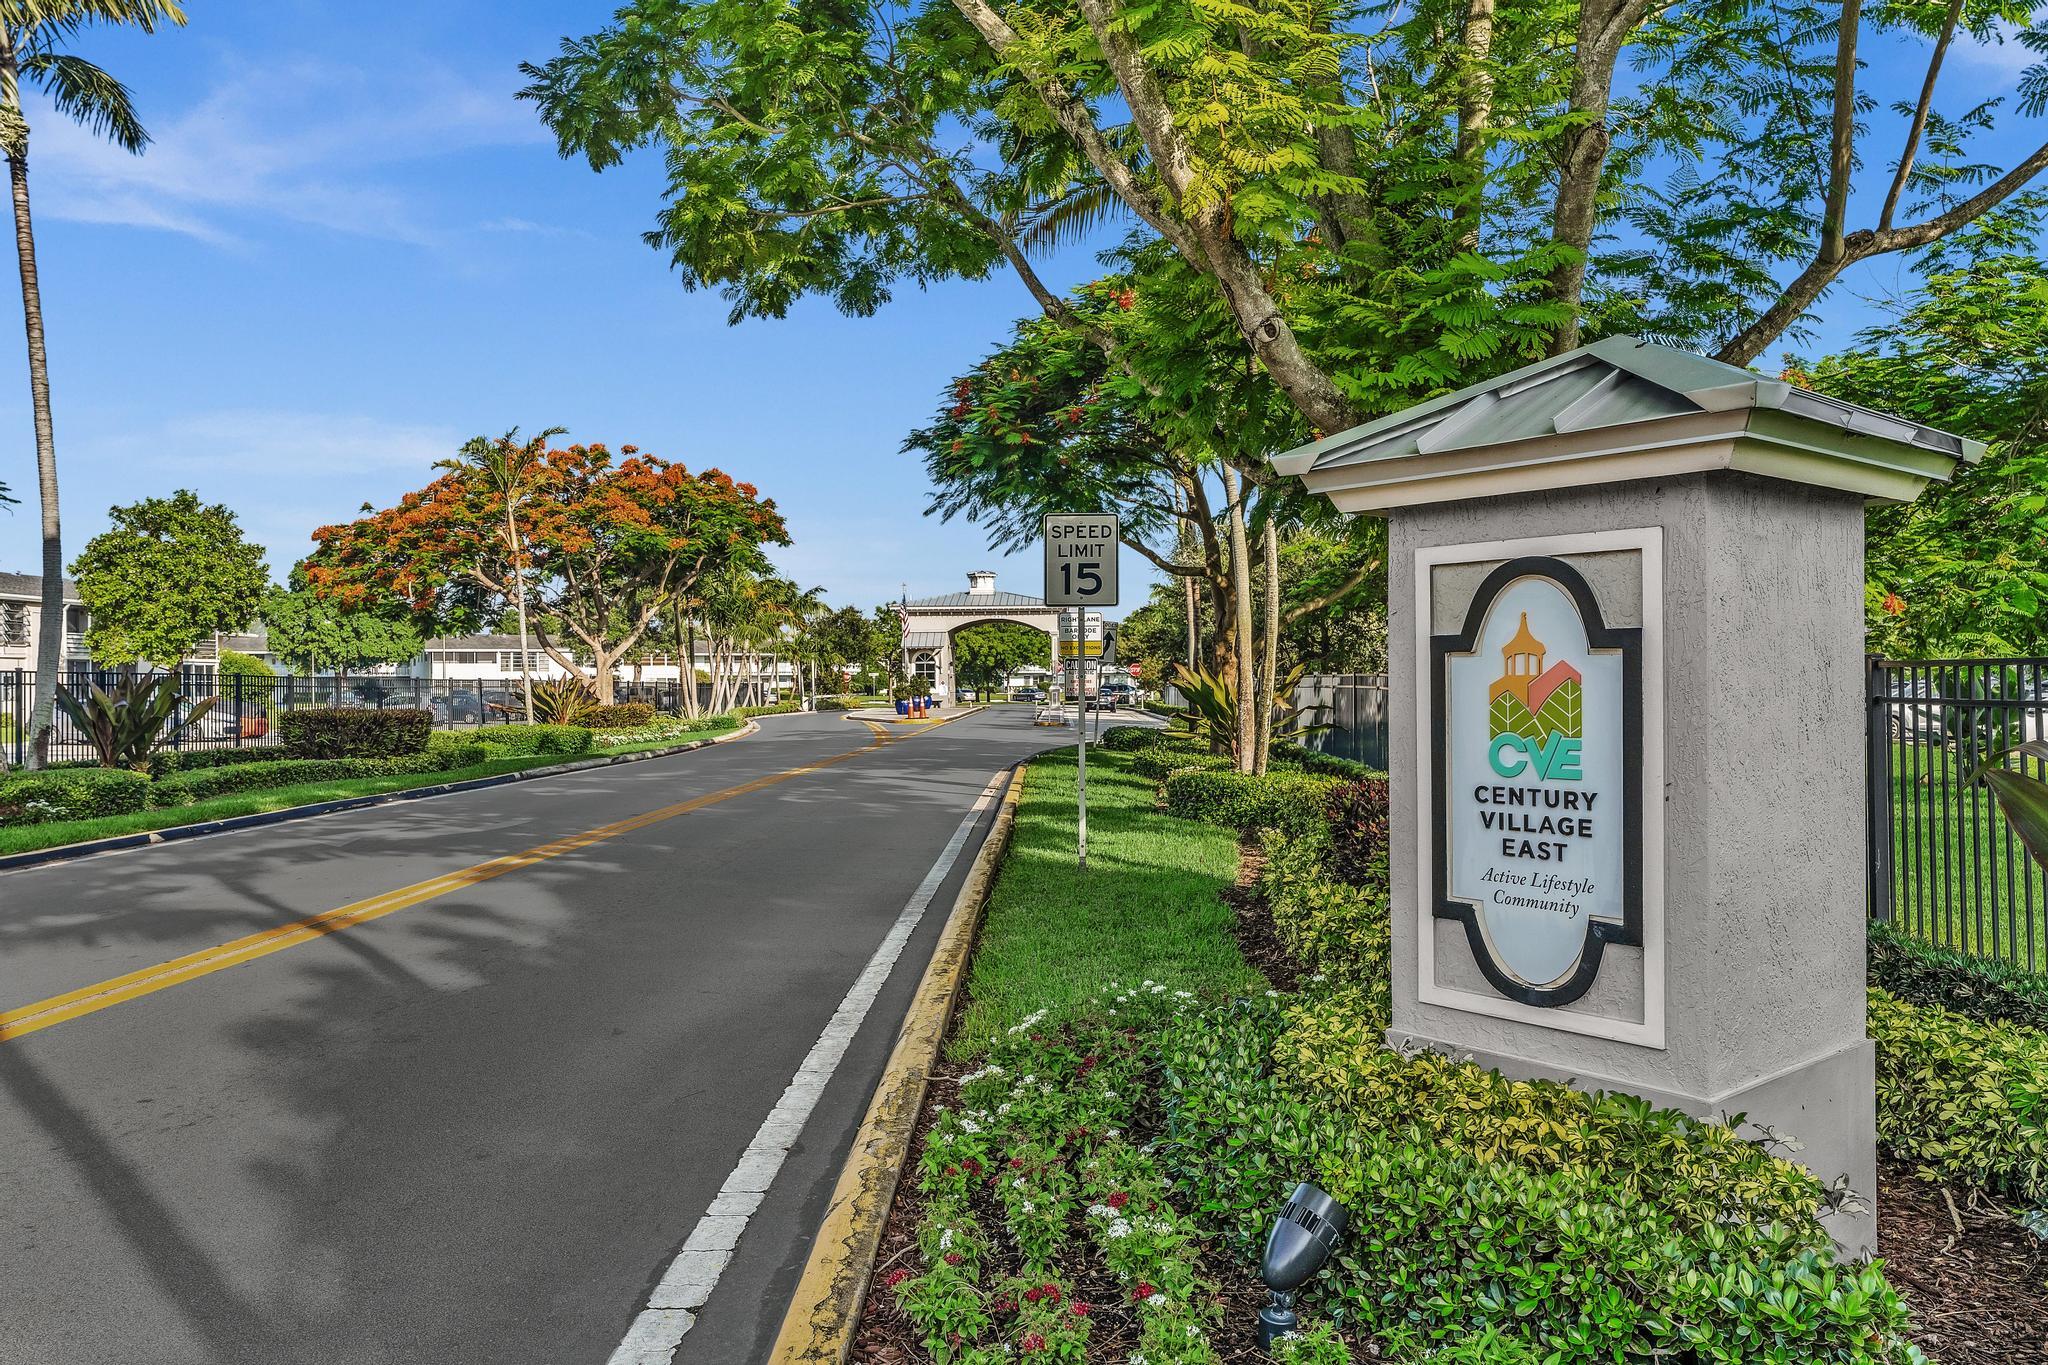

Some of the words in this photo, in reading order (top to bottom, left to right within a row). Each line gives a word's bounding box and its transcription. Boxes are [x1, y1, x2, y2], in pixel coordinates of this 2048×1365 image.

[1052, 525, 1112, 539] SPEED
[1058, 544, 1105, 558] LIMIT
[1060, 562, 1103, 596] 15
[1066, 660, 1097, 670] CAUION
[1488, 729, 1583, 782] CVE
[1474, 785, 1597, 811] CENTURY
[1479, 811, 1593, 838] VILLAGE
[1502, 838, 1569, 862] EAST
[1480, 866, 1527, 887] Active
[1530, 871, 1596, 898] Lifestyle
[1493, 889, 1580, 920] Community
